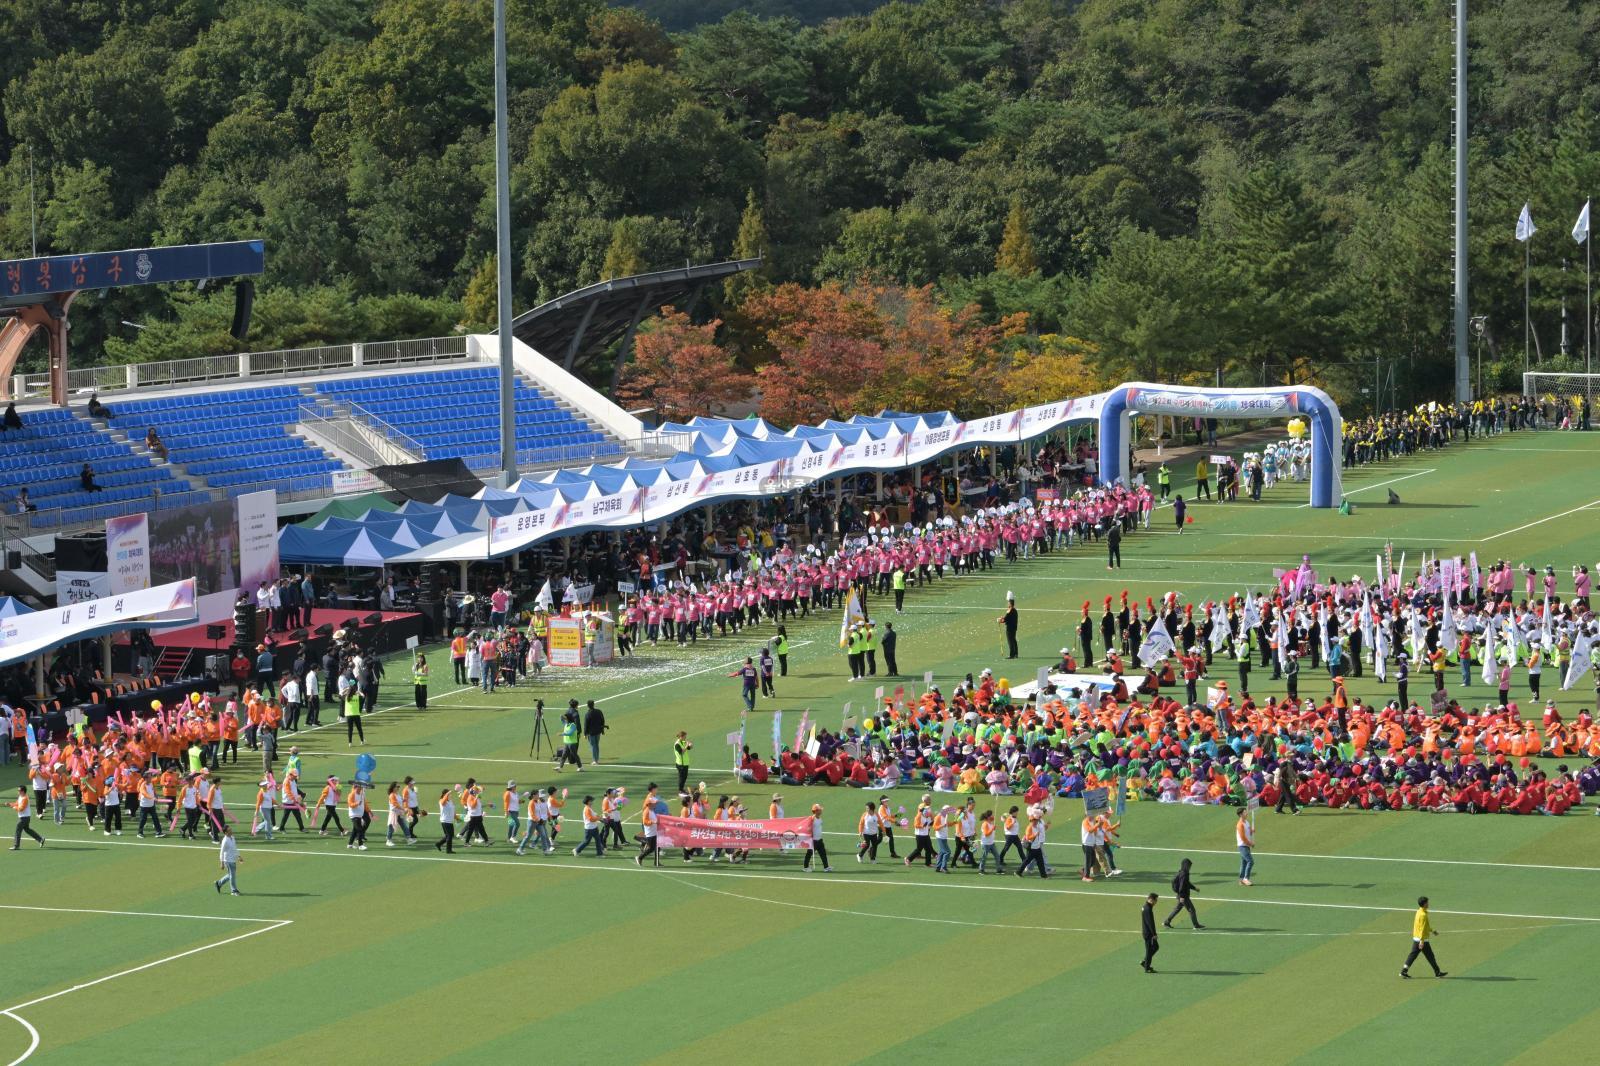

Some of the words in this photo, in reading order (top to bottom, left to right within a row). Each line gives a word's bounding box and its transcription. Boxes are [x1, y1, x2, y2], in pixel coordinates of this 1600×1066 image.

[666, 481, 690, 498] 삼산동
[592, 497, 623, 516] 남구체육회
[517, 512, 546, 531] 운영본부
